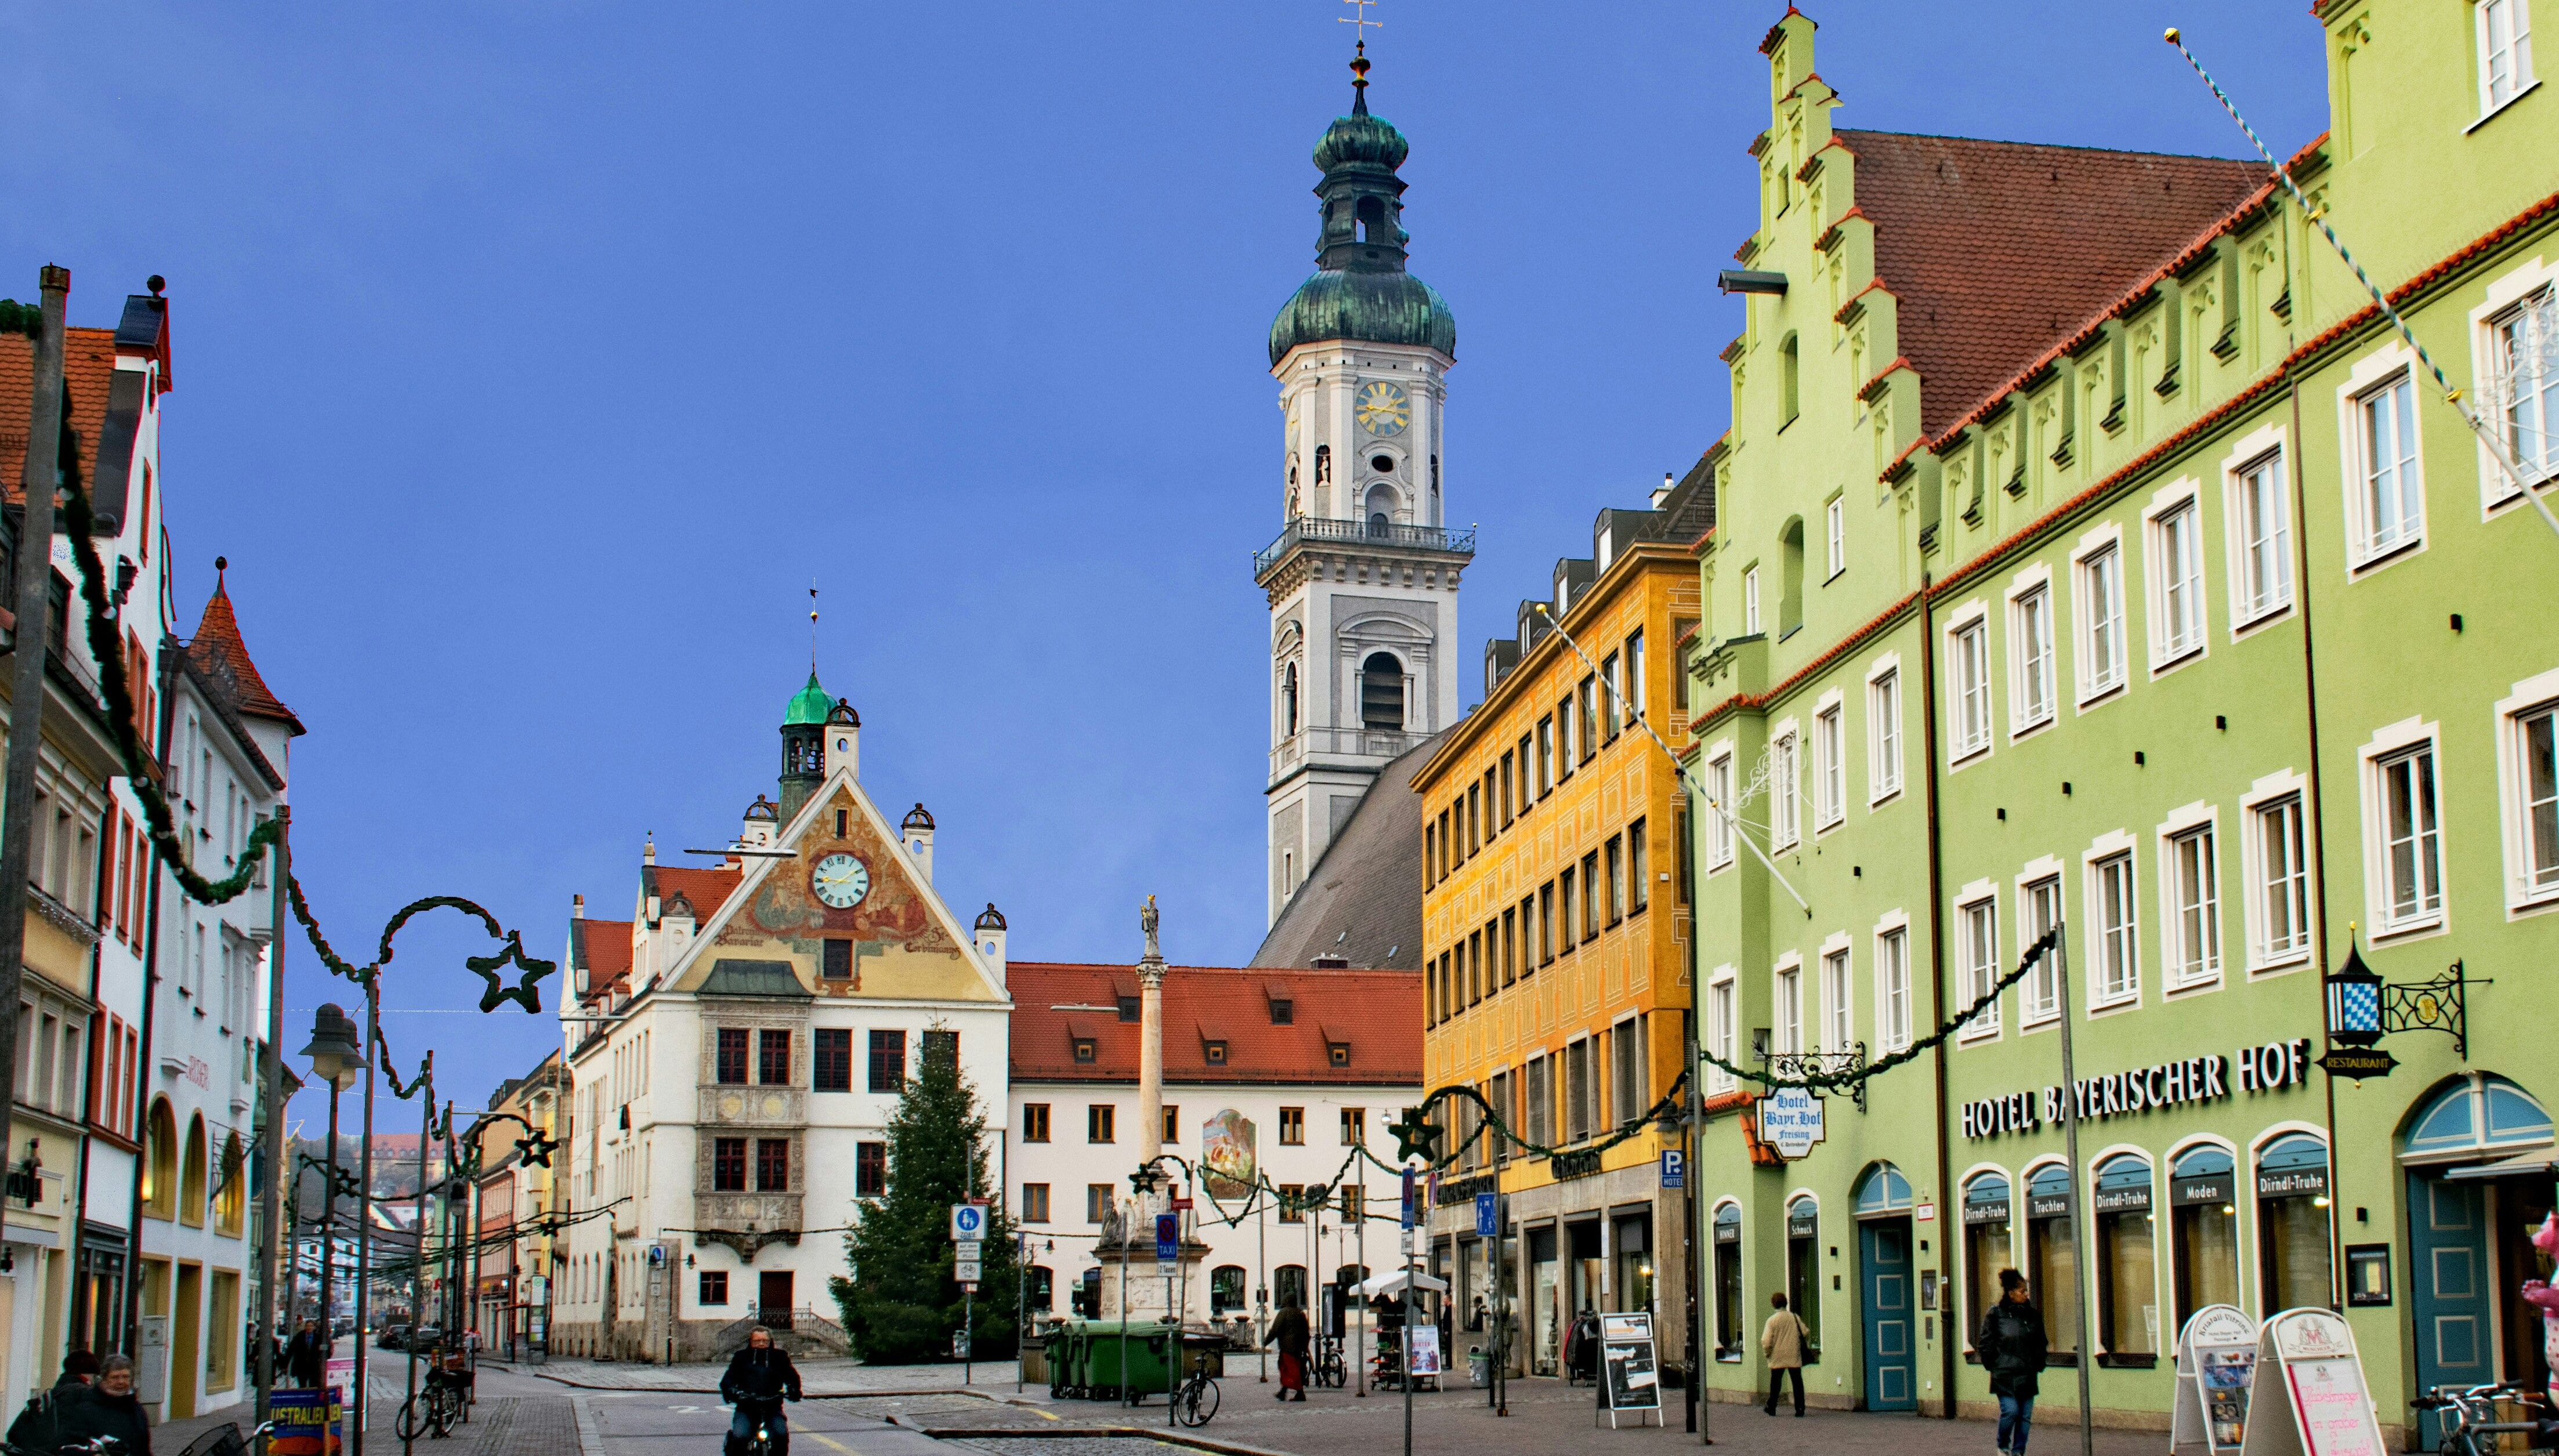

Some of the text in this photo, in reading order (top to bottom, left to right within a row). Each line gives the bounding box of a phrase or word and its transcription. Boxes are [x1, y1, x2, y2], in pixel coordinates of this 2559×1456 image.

[2326, 1057, 2389, 1069] RESTAURANT
[1960, 1092, 2033, 1138] HOTEL
[2236, 1038, 2303, 1091] HOF
[1777, 1094, 1808, 1109] Hotel
[1779, 1129, 1810, 1140] Freising
[1666, 1151, 1682, 1174] P
[2260, 1174, 2323, 1192] Dirndl-Truhe
[2096, 1191, 2148, 1208] Dirndl-Truhe
[2187, 1185, 2217, 1200] Moden
[1965, 1205, 2007, 1220] Dirndl-Truhe
[2035, 1200, 2065, 1214] Trachten
[1159, 1245, 1176, 1255] TAXI
